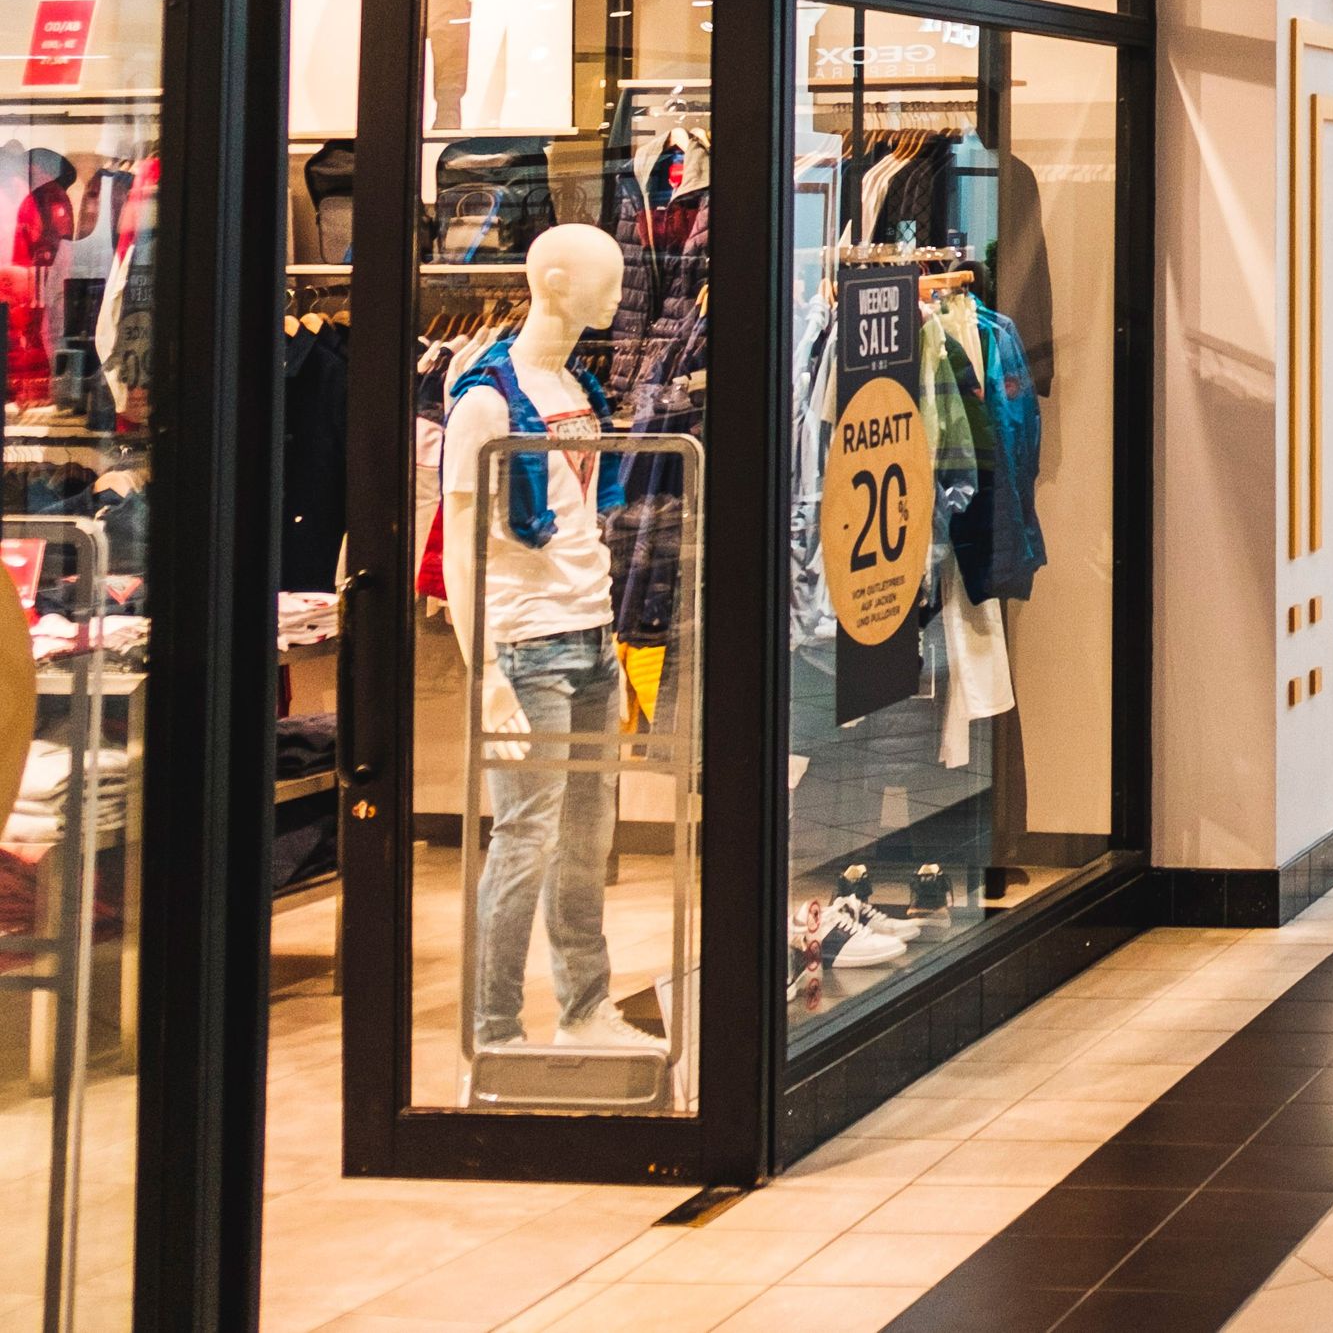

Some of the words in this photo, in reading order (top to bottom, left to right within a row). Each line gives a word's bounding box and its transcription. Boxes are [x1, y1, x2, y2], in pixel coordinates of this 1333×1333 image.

[858, 286, 900, 315] WEEKEND
[859, 315, 900, 357] SALE
[843, 412, 913, 455] RABATT
